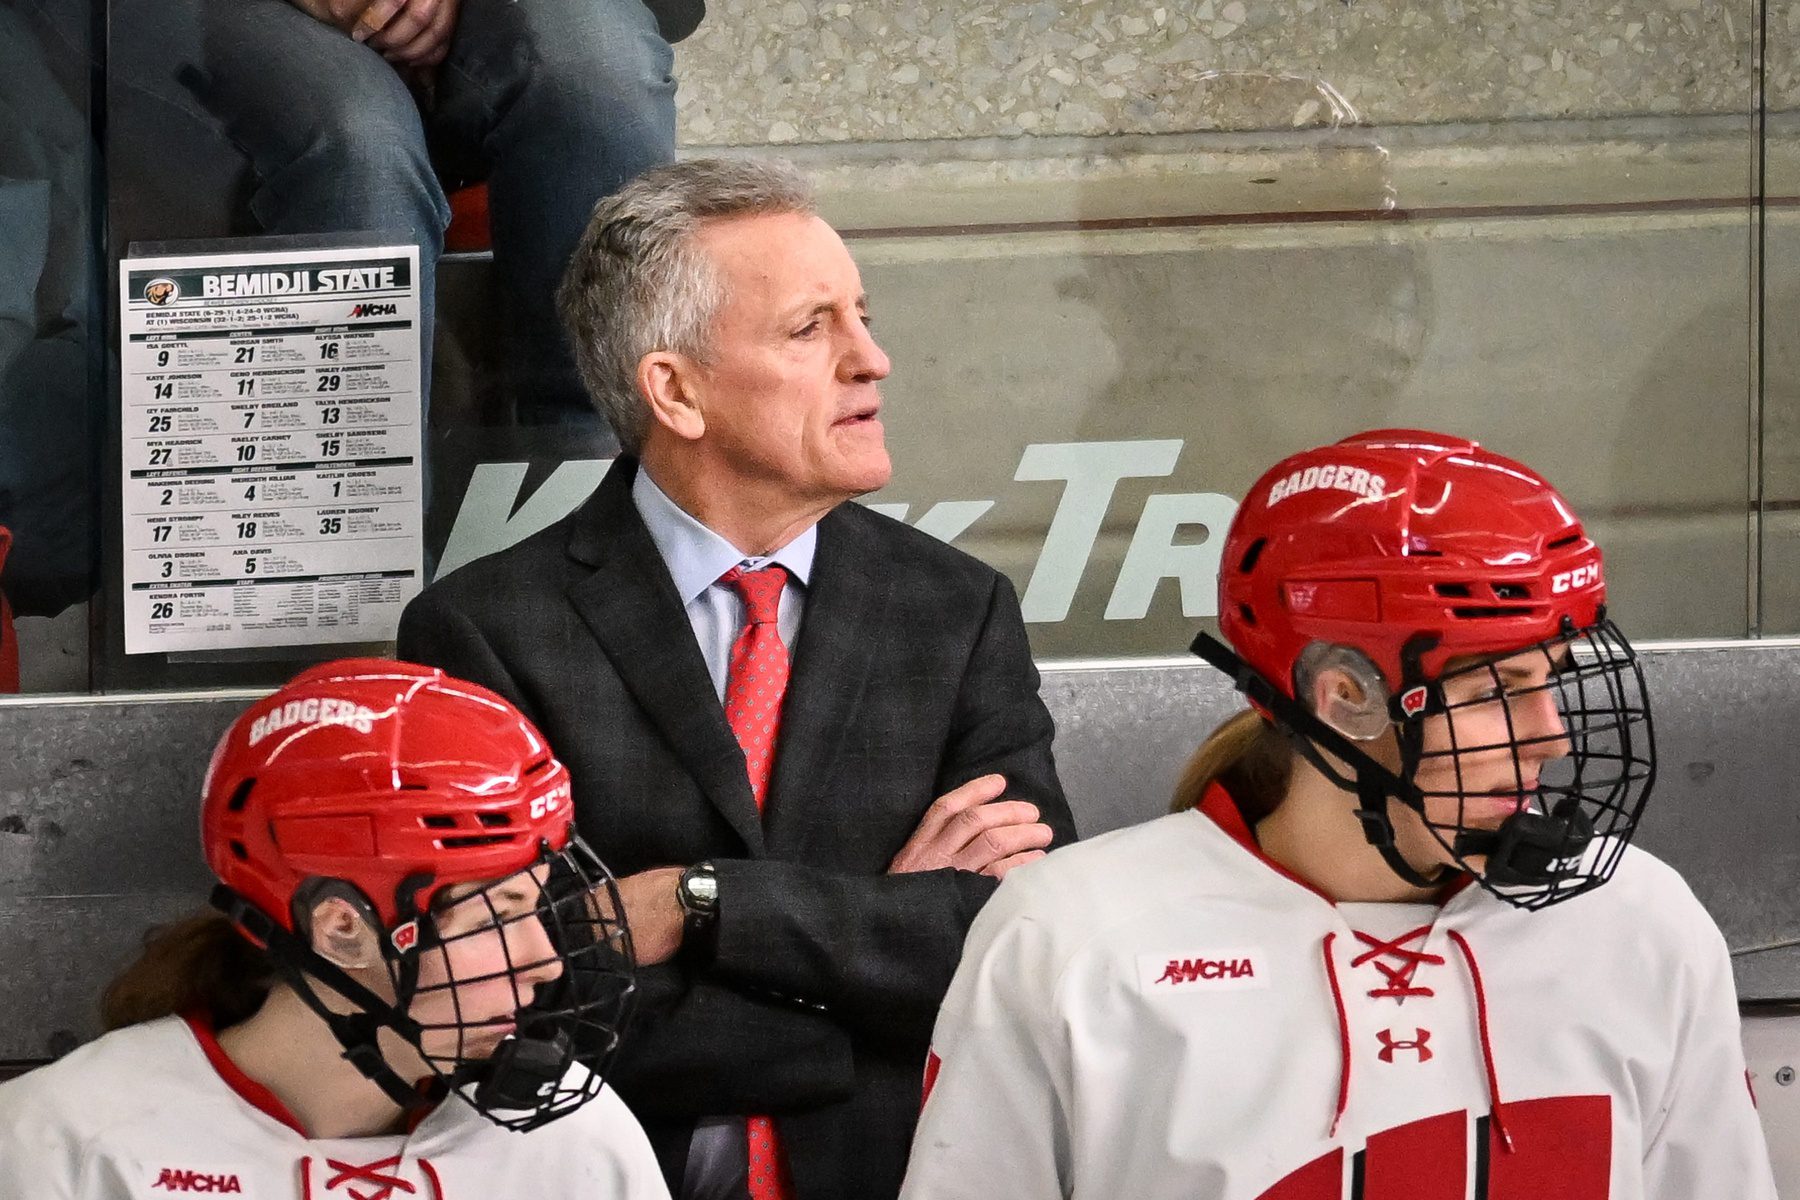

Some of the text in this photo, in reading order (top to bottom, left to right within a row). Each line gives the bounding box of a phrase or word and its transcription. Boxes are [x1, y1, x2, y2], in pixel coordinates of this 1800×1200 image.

[202, 266, 395, 297] BEMIDJI STATE
[169, 317, 212, 325] WISCONSIN
[274, 313, 299, 321] WCHA)
[348, 303, 397, 319] WCHA
[157, 350, 169, 367] 9
[234, 346, 255, 363] 21
[320, 342, 339, 359] 16
[154, 383, 173, 399] 14
[238, 378, 255, 396] 11
[317, 375, 340, 392] 29
[148, 416, 172, 432] 25
[244, 412, 255, 429] 7
[321, 407, 340, 424] 13
[149, 448, 172, 465] 27
[237, 445, 256, 461] 10
[321, 440, 340, 456] 15
[244, 485, 255, 501] 4
[333, 481, 341, 497] 1
[1266, 465, 1386, 509] BADGERS
[160, 489, 173, 506] 2
[152, 526, 172, 542] 17
[237, 522, 256, 538] 18
[319, 518, 341, 534] 35
[1014, 439, 1238, 622] TR
[161, 561, 173, 578] 3
[245, 557, 257, 574] 5
[1552, 561, 1599, 593] CCM
[151, 602, 173, 619] 26
[248, 697, 373, 748] BADGERS
[1155, 958, 1254, 985] WCHA
[151, 1167, 242, 1193] WCHA
